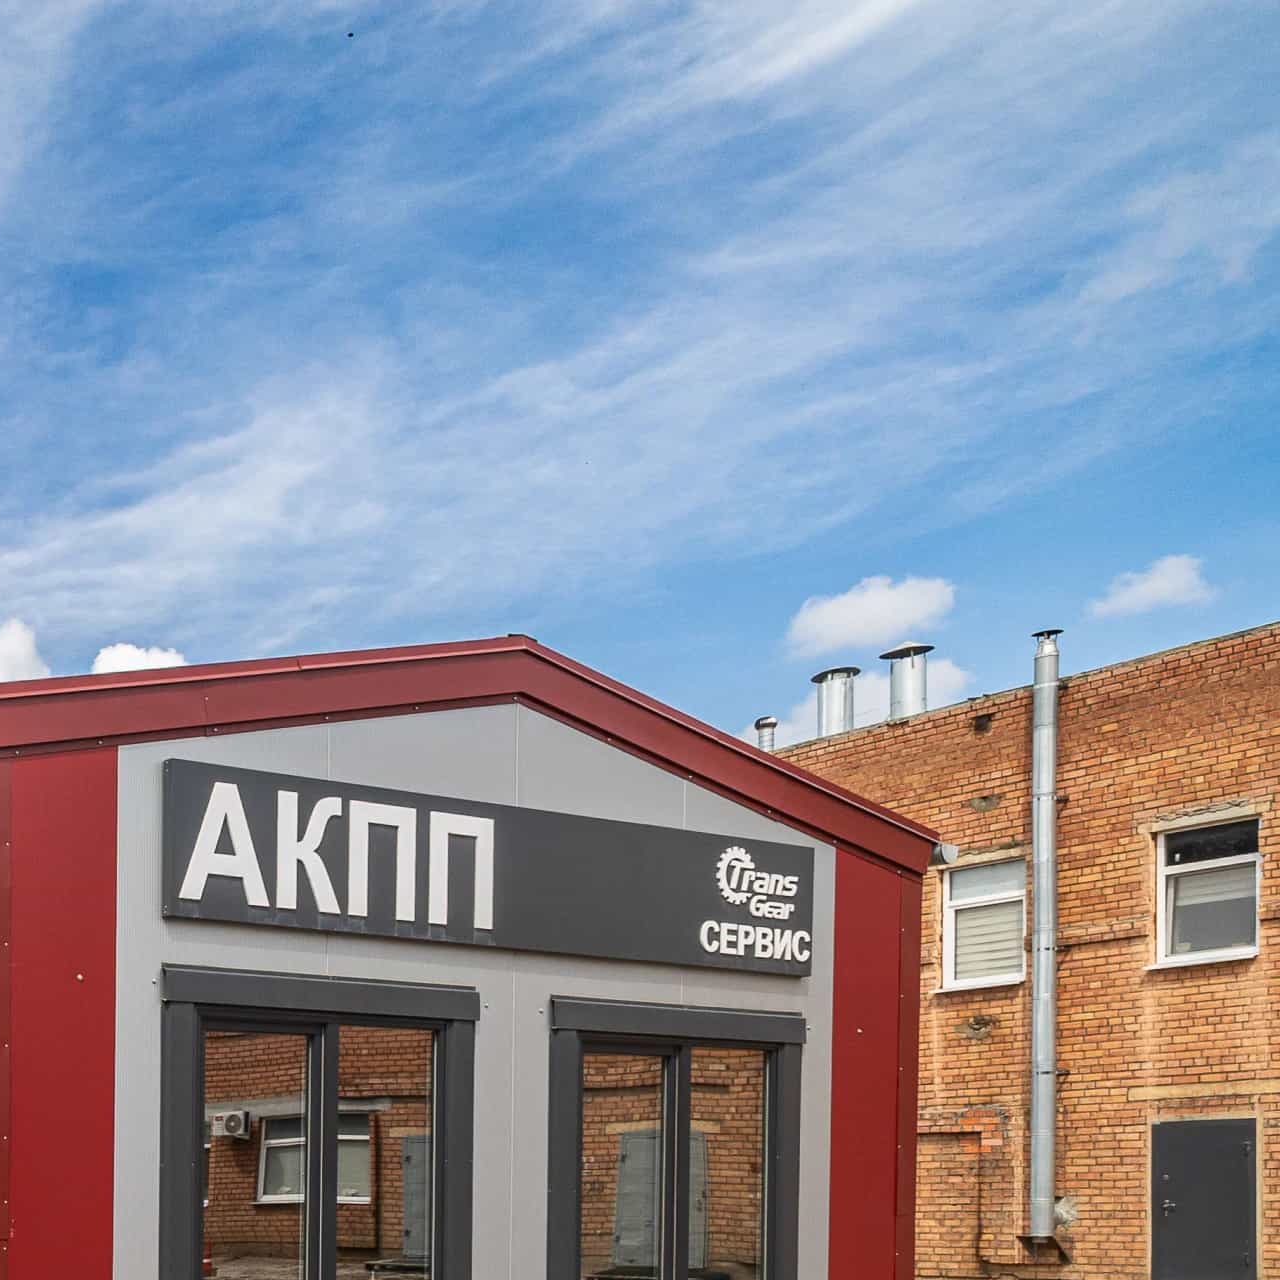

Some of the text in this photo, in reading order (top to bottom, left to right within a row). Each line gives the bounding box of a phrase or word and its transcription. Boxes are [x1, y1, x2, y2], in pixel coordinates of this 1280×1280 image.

[178, 780, 496, 931] АКПП
[729, 859, 800, 898] Trans
[749, 894, 796, 921] Gear
[699, 919, 812, 963] СЕРВИС
